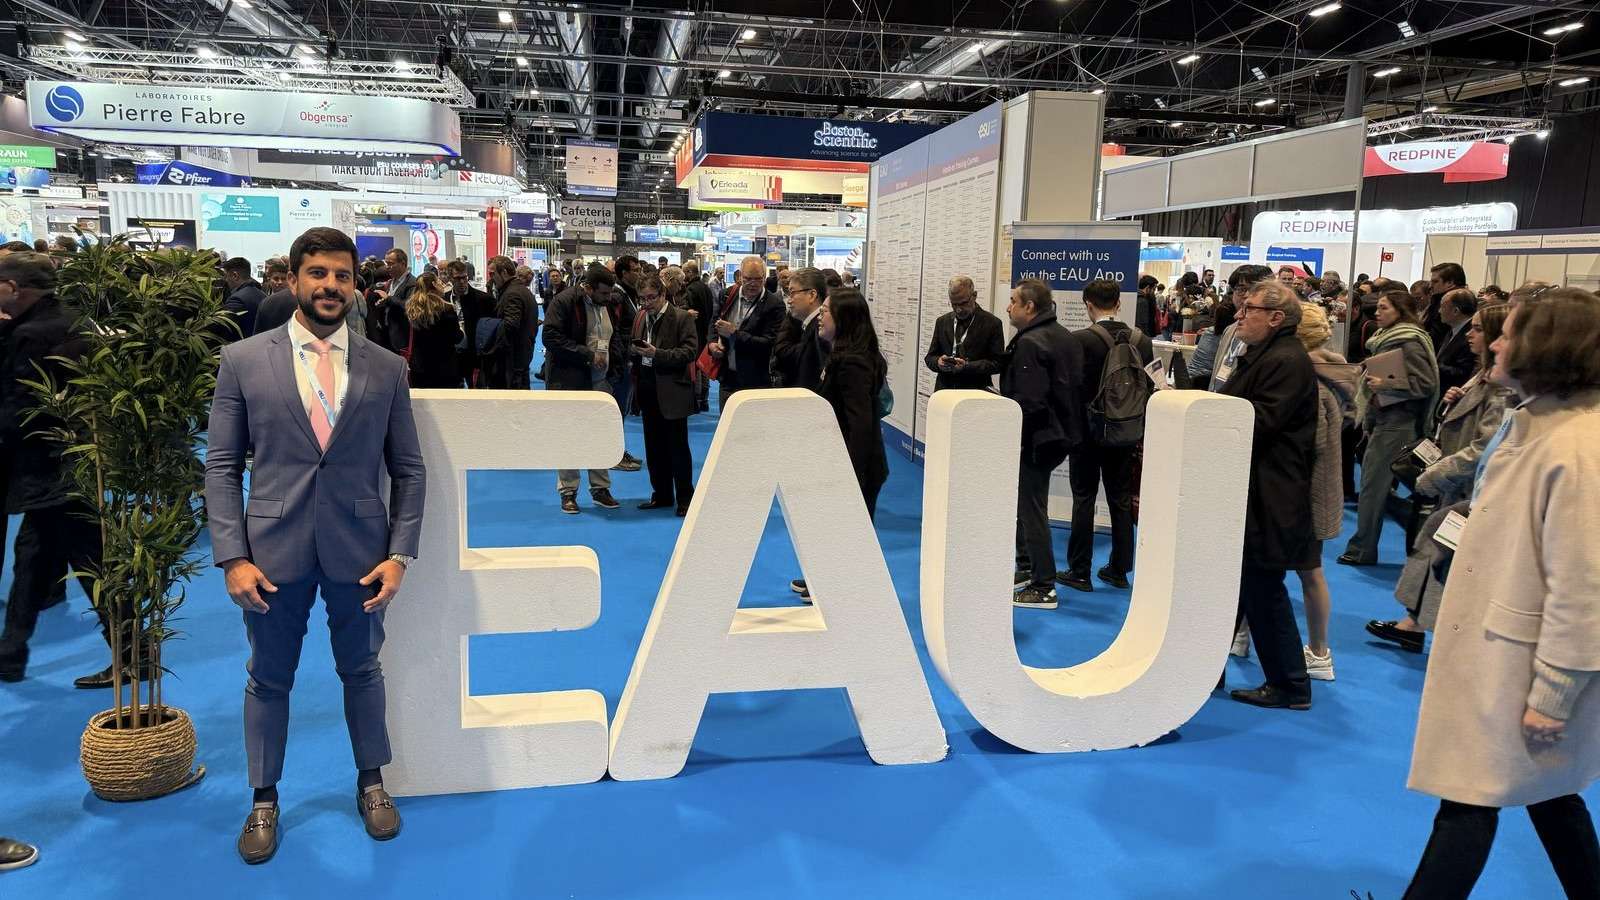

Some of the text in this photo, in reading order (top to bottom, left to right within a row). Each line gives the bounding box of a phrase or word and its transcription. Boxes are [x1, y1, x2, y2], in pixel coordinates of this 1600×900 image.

[135, 92, 213, 102] LABORATOIRES
[103, 103, 246, 126] Pierre Fabre
[300, 111, 348, 124] Obgemsa
[823, 121, 864, 137] Boston
[814, 130, 878, 149] Scientific
[810, 149, 839, 157] Advancing
[1388, 148, 1457, 161] REDPINE
[331, 165, 356, 175] MAKE
[185, 172, 212, 186] Pfizer
[624, 211, 674, 220] RESTAURNTE
[1466, 215, 1492, 223] Integrated
[1280, 221, 1355, 233] REDPINE
[1474, 222, 1498, 230] Portfolio
[1021, 249, 1110, 261] Connect with us
[1020, 269, 1036, 280] via
[1038, 270, 1056, 280] the
[1060, 267, 1089, 281] EAU
[381, 388, 1255, 797] EAU
